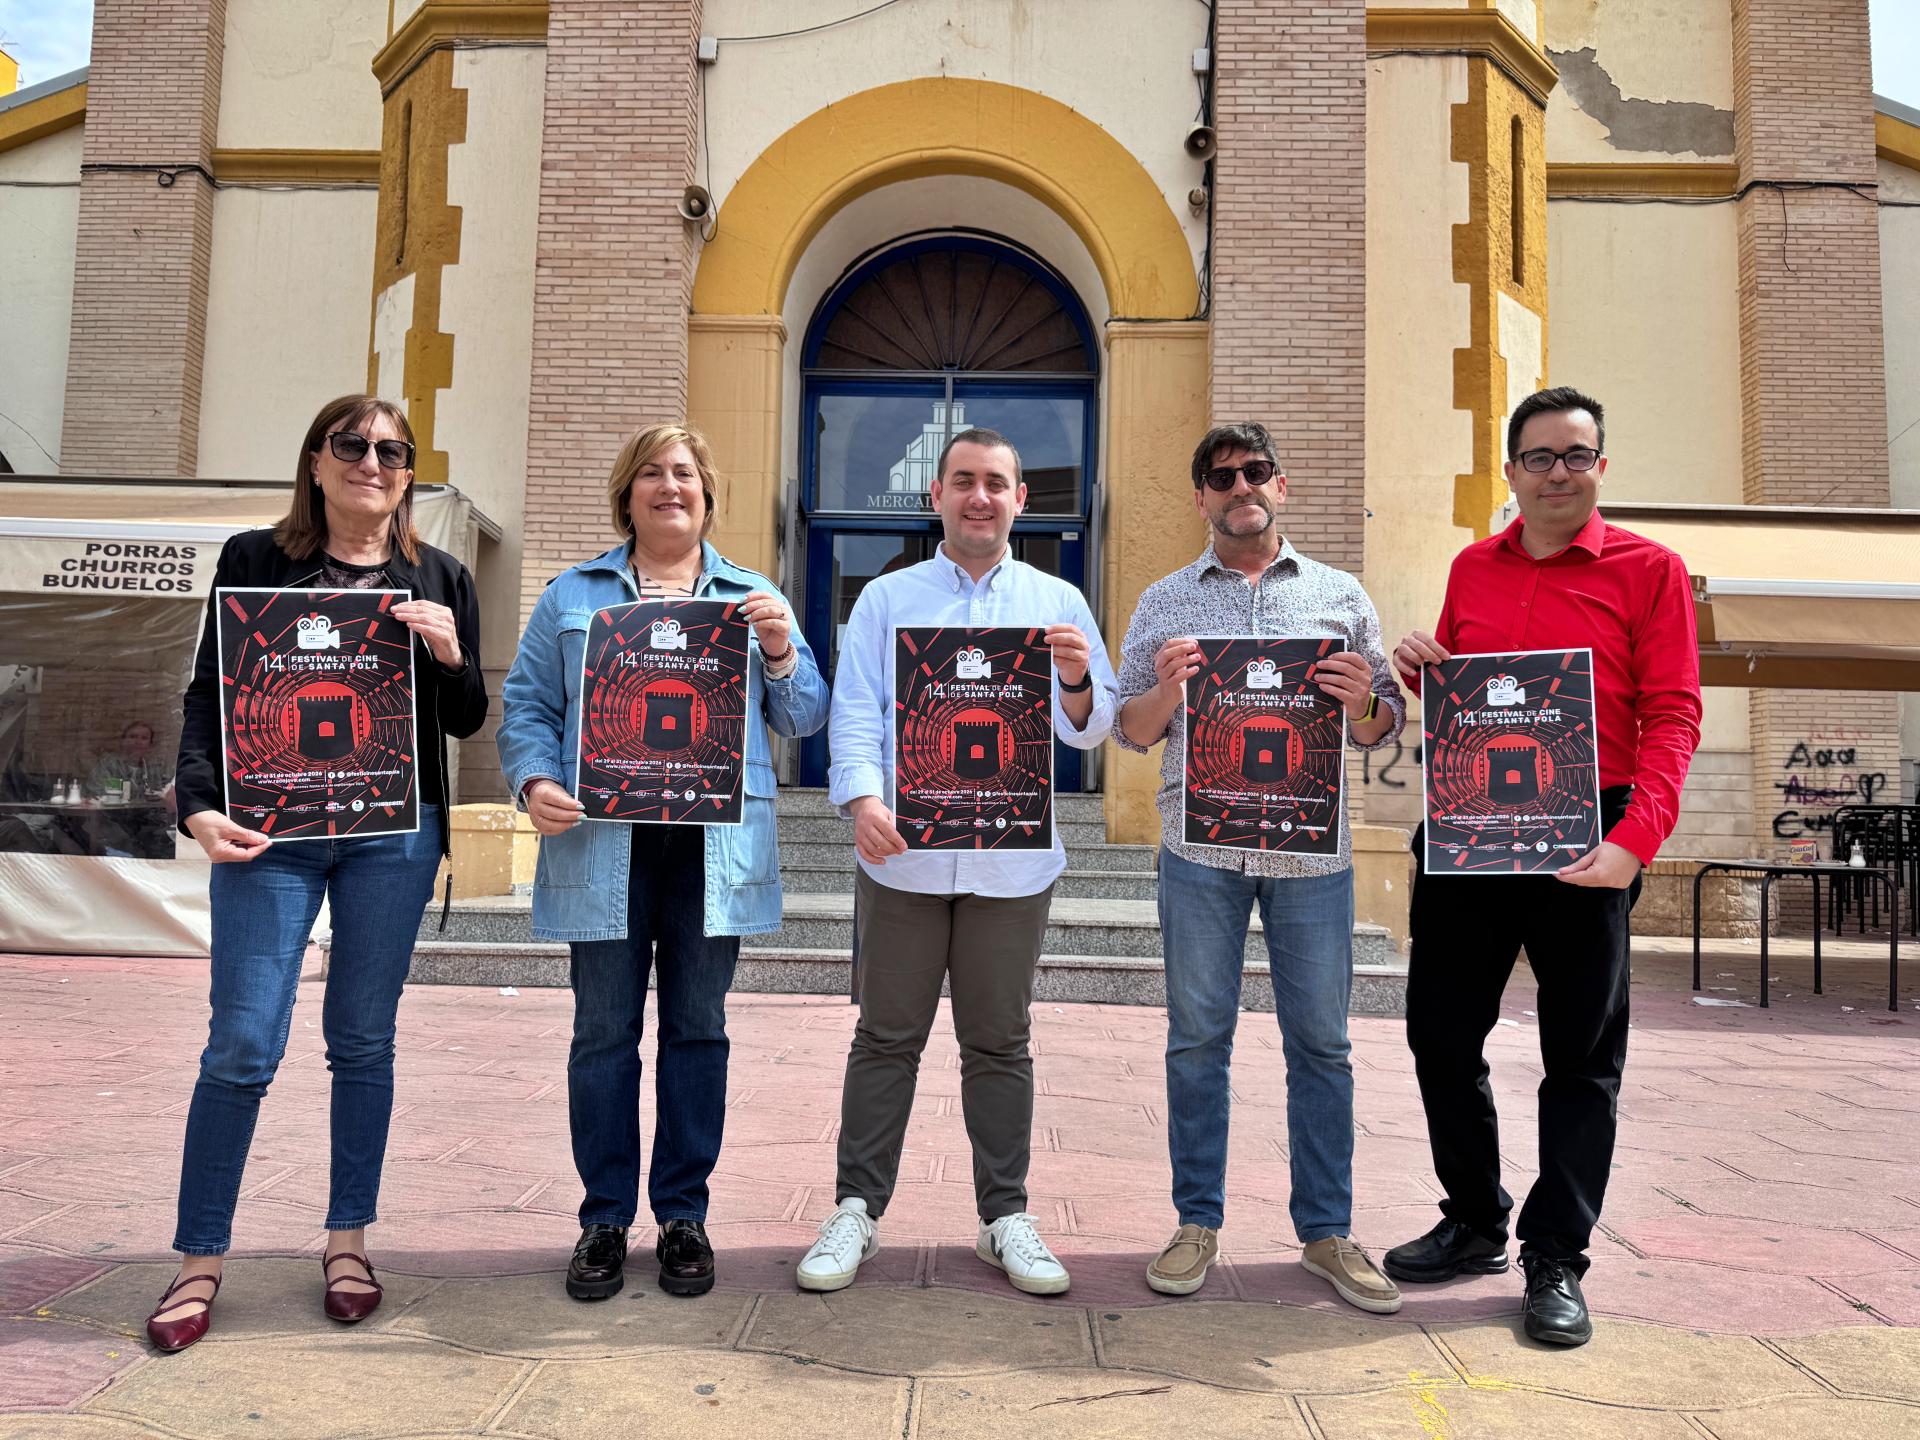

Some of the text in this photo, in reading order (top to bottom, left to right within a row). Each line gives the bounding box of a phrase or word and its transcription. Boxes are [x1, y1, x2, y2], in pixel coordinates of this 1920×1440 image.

[86, 543, 197, 559] PORRAS
[61, 558, 194, 575] CHURROS
[43, 573, 193, 592] BUÑUELOS
[644, 654, 684, 663] FESTIVAL
[658, 662, 689, 670] SANTA
[694, 664, 719, 672] POLA
